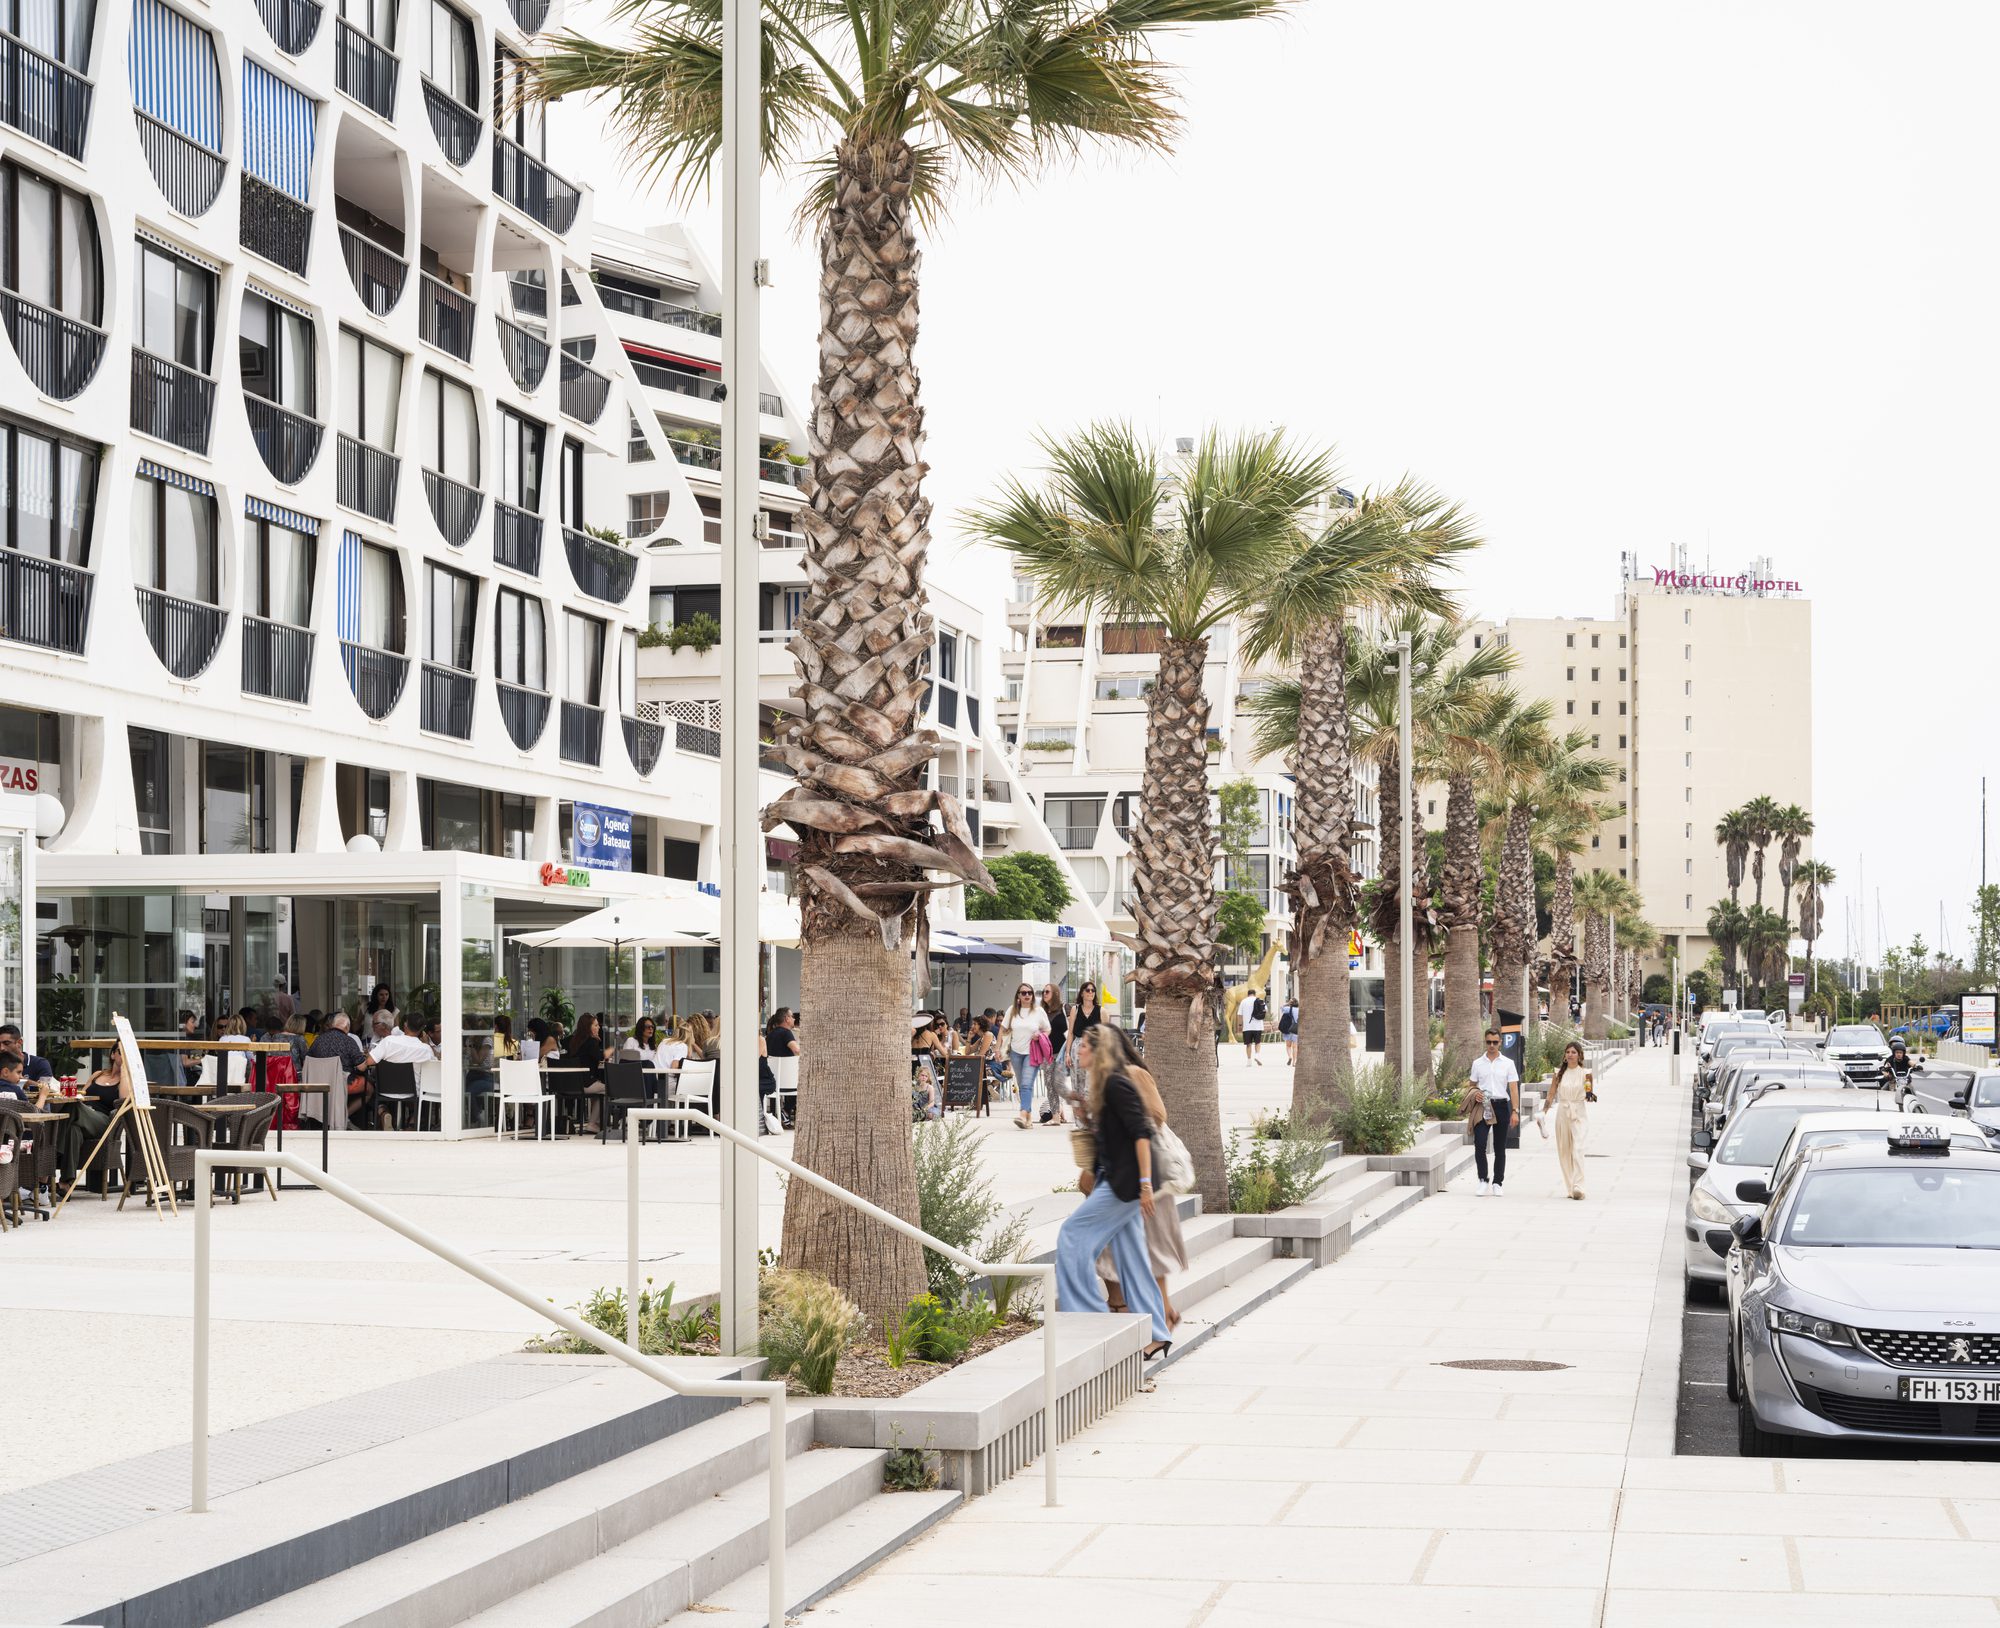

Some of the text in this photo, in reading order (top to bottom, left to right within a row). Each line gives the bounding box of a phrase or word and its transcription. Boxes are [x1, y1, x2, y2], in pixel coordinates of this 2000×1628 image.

[1650, 564, 1803, 592] Mercure HOTEL
[579, 819, 599, 836] Sammy
[604, 816, 630, 833] Agence
[602, 833, 631, 850] Bateaux
[1902, 1126, 1939, 1136] TAXI
